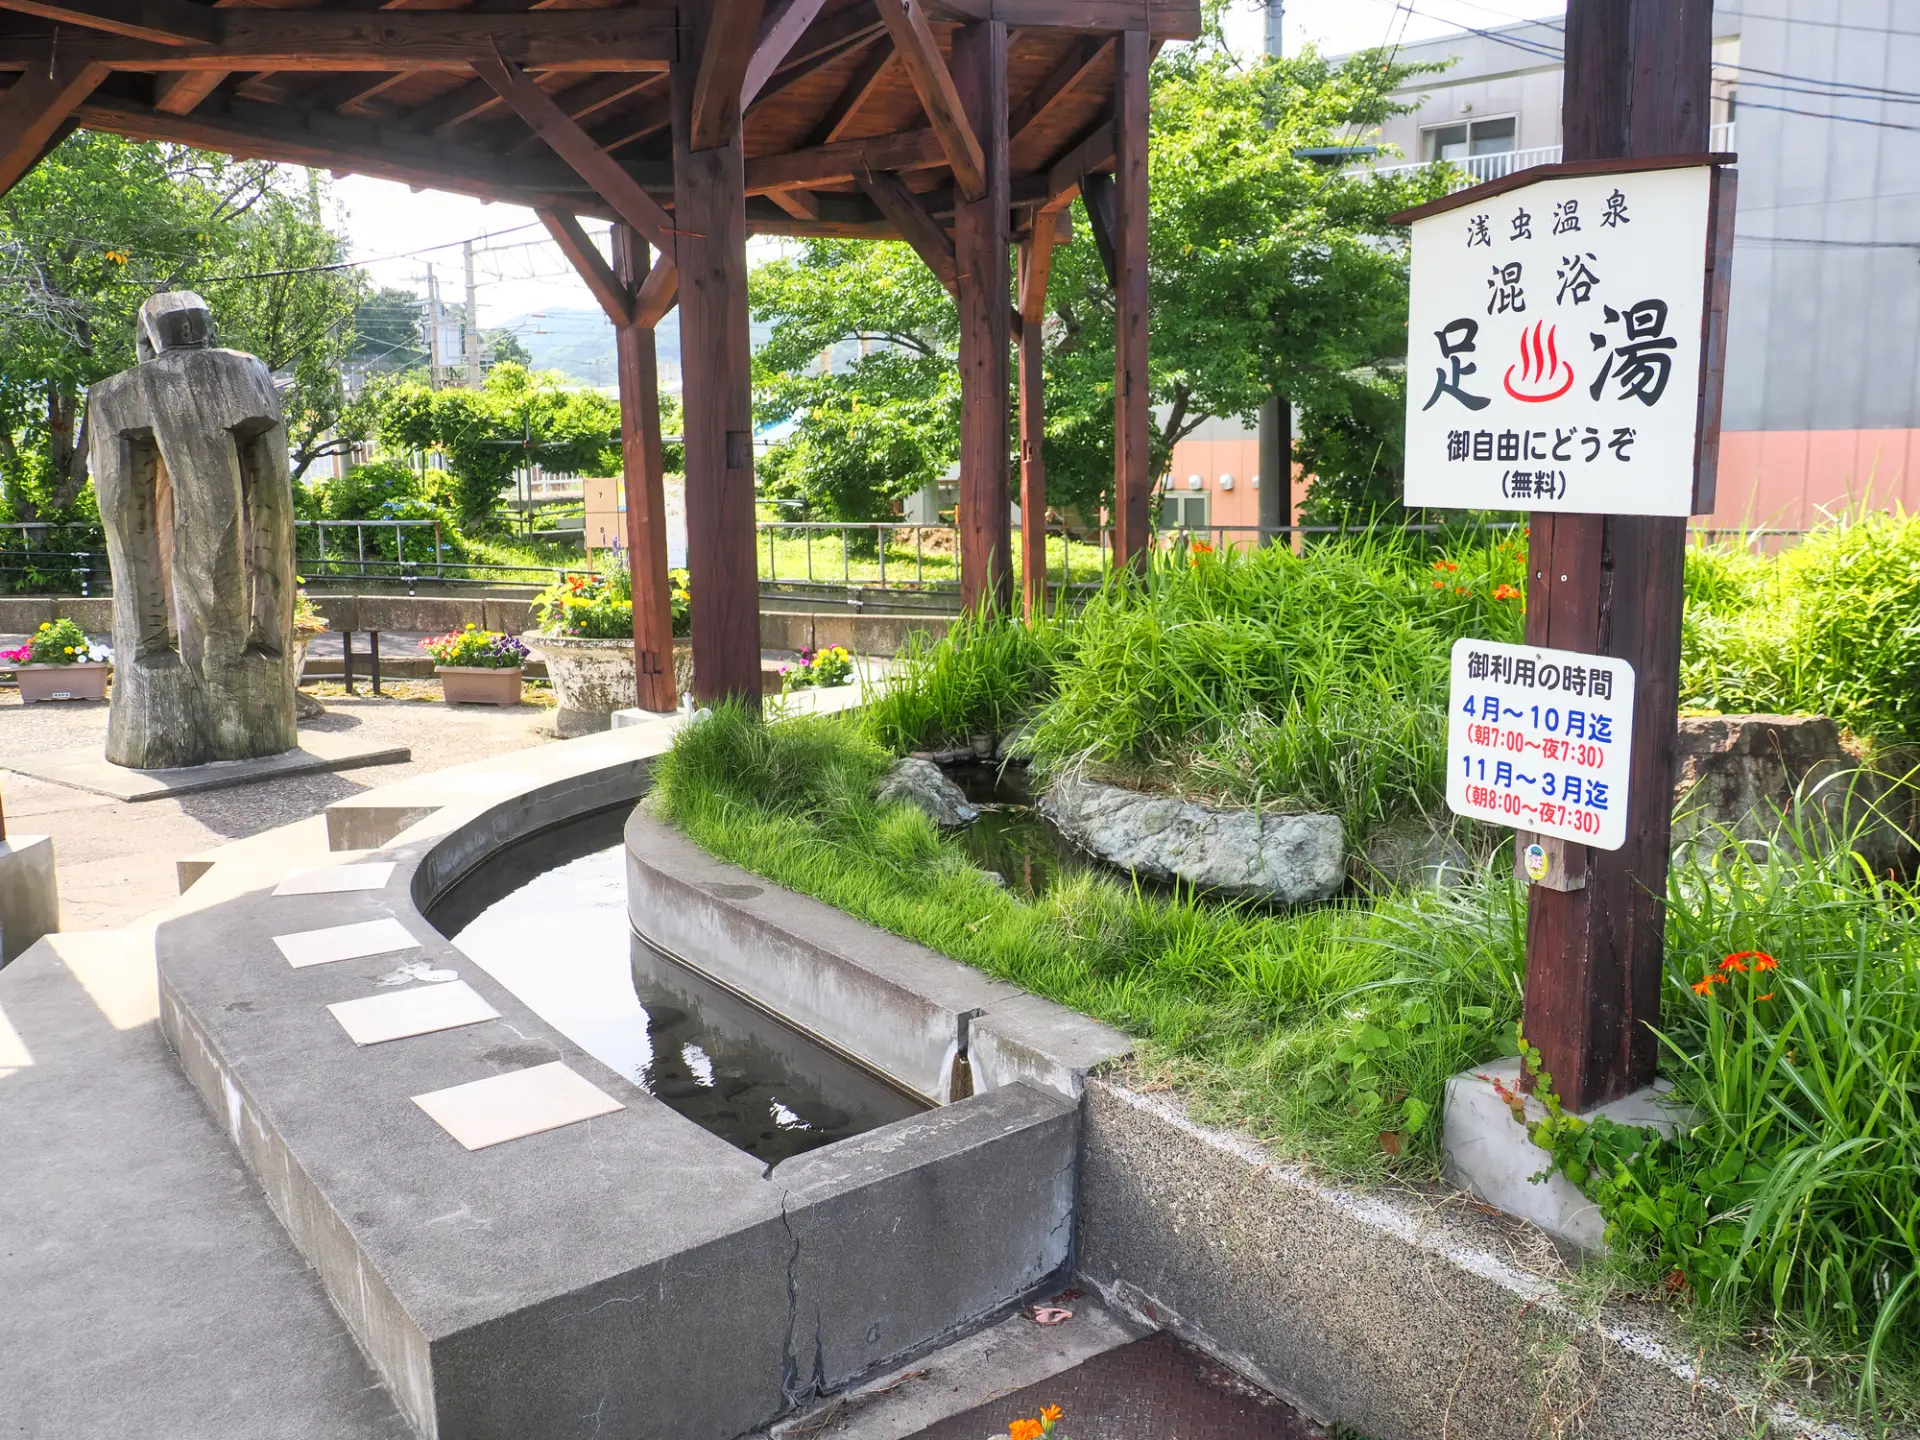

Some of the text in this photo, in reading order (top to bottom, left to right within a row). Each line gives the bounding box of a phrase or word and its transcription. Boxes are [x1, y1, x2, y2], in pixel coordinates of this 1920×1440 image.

[1467, 188, 1631, 248] 浅虫温泉
[1487, 252, 1601, 316] 混浴
[1446, 426, 1637, 463] 御自由にどうぞ
[1501, 470, 1567, 500] (無料)
[1467, 651, 1613, 701] 御利用の時間
